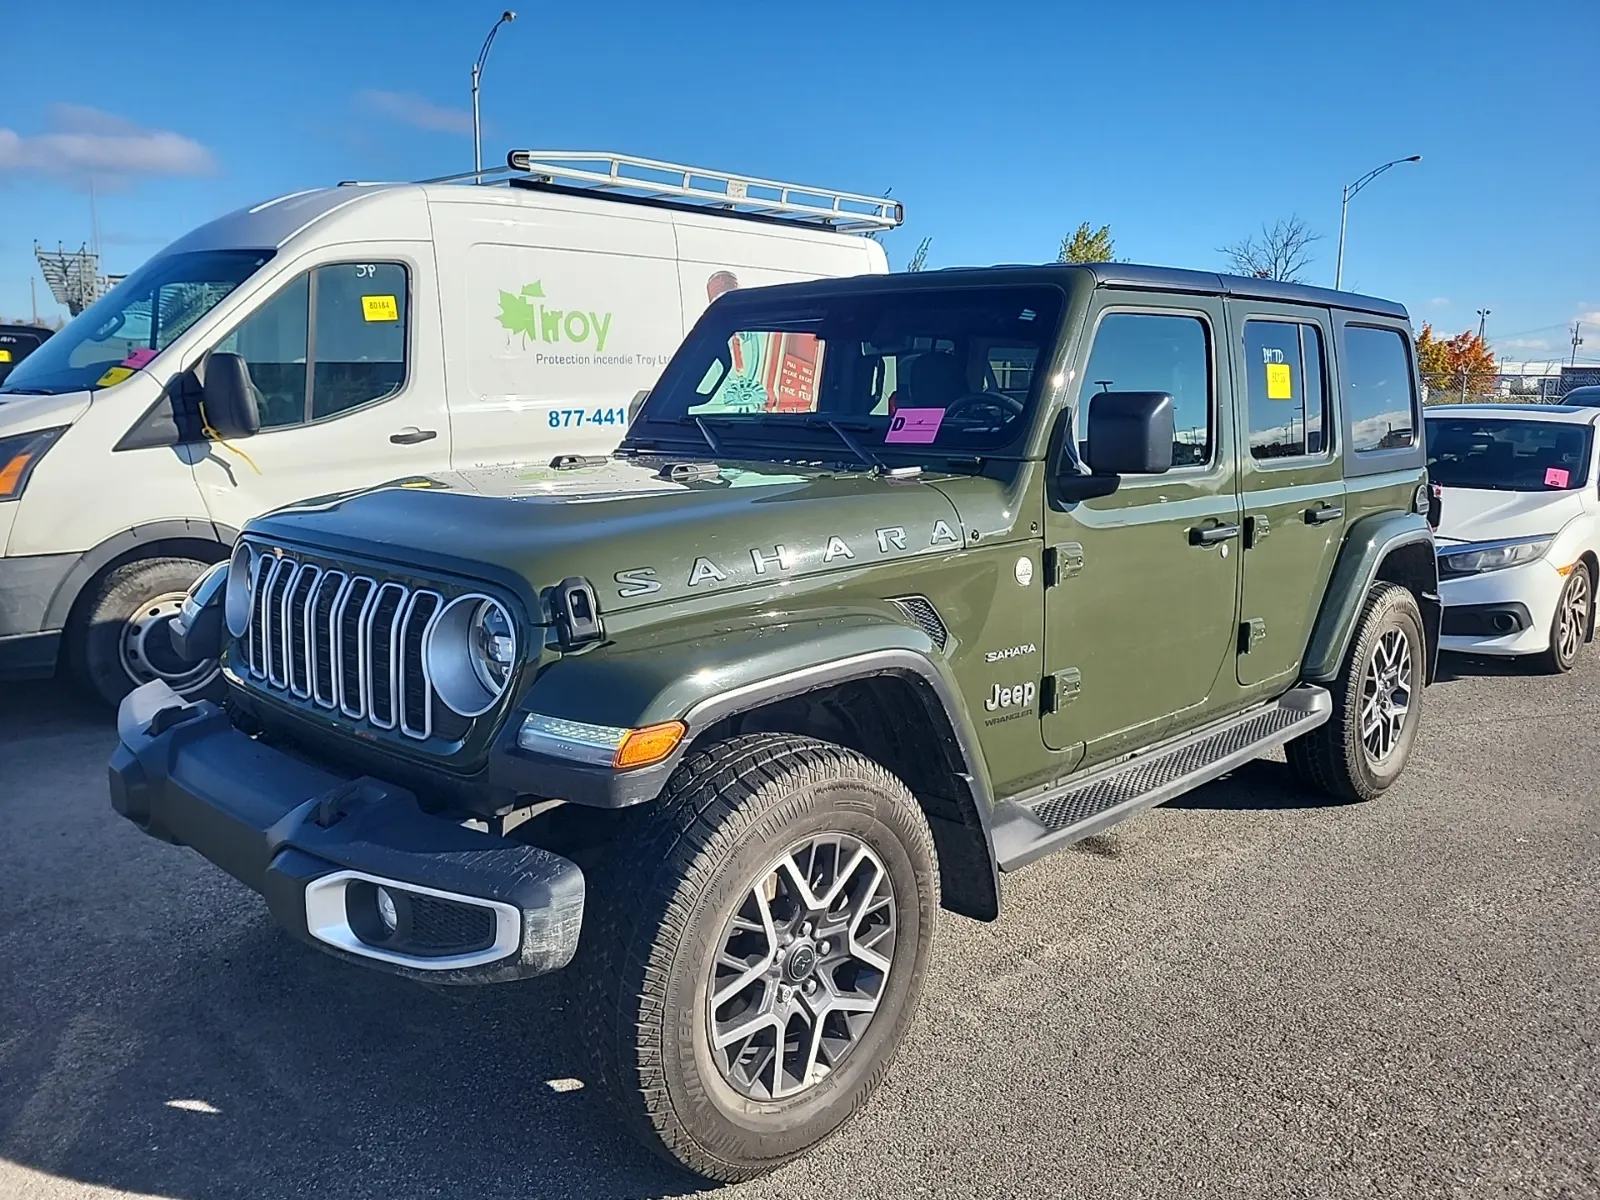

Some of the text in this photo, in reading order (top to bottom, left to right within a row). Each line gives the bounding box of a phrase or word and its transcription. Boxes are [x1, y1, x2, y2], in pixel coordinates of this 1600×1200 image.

[521, 293, 612, 352] Troy
[536, 353, 590, 365] Protection
[593, 353, 633, 365] incendie
[636, 354, 658, 367] Troy
[613, 519, 958, 598] SAHARA
[985, 643, 1037, 663] SAHARA
[984, 681, 1036, 712] Jeep
[985, 709, 1033, 727] WRANGLER
[677, 1006, 709, 1113] WINTER
